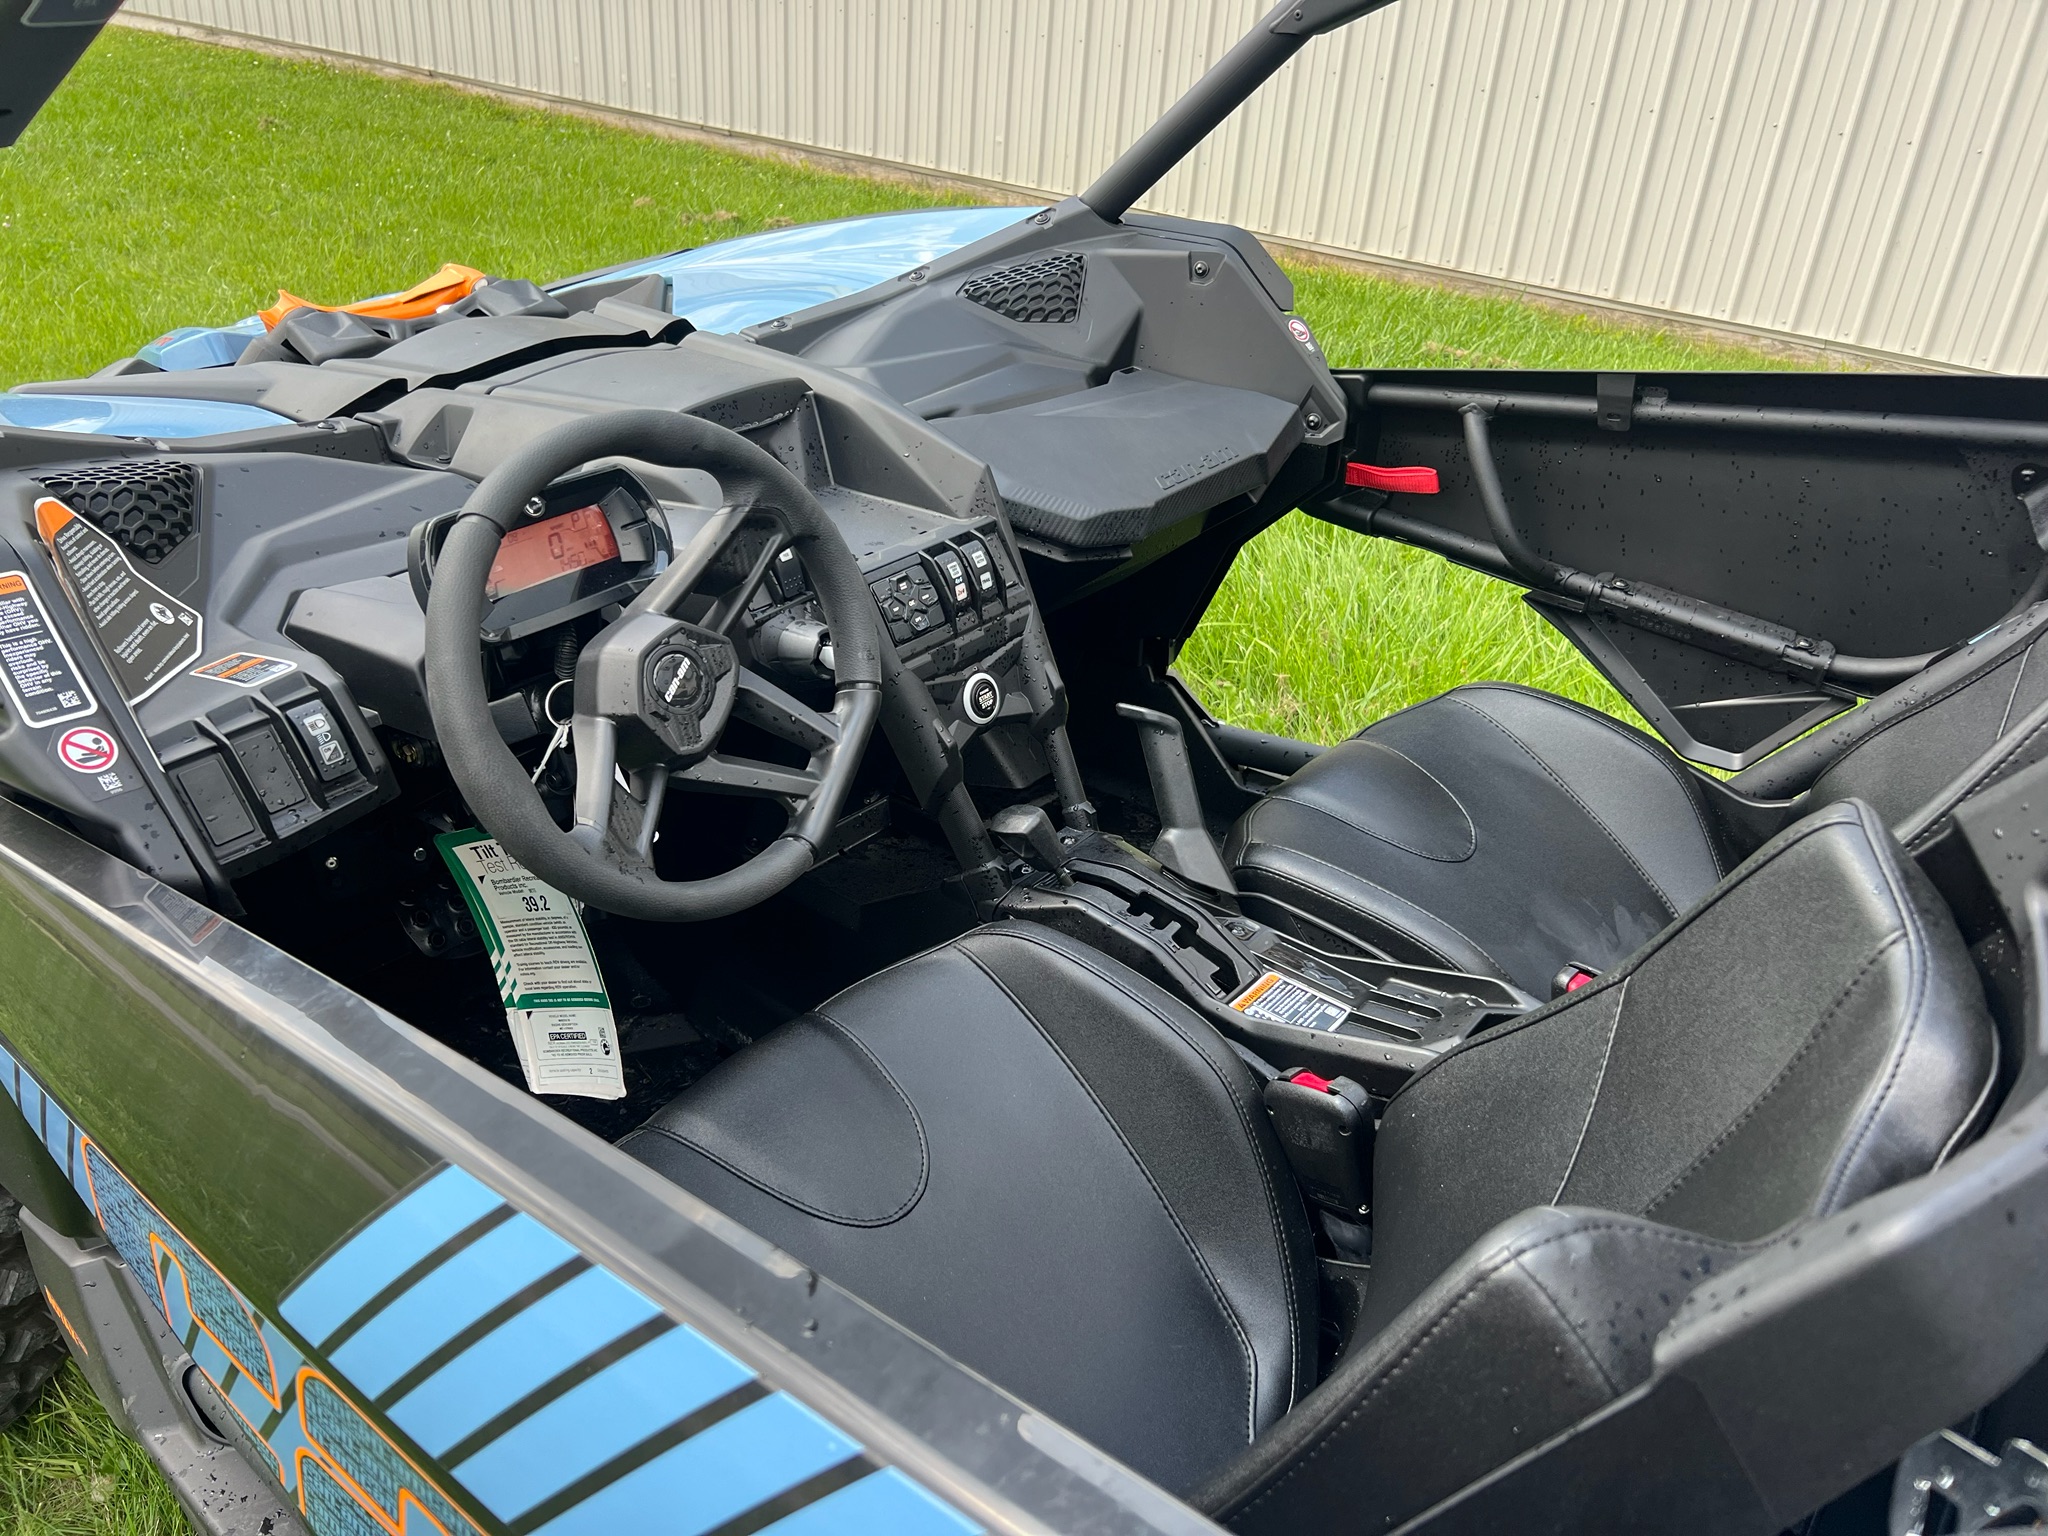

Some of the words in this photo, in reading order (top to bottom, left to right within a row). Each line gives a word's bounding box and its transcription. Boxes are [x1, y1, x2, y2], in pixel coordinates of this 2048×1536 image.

[1154, 446, 1240, 490] can-am
[664, 657, 691, 703] can-am
[979, 690, 994, 703] START
[981, 699, 993, 709] STOP
[469, 844, 499, 860] Tilt
[476, 857, 508, 874] Test
[491, 877, 521, 885] Bombardier
[522, 895, 551, 912] 39.2
[1242, 978, 1274, 1003] WARNING
[589, 1067, 593, 1075] 2
